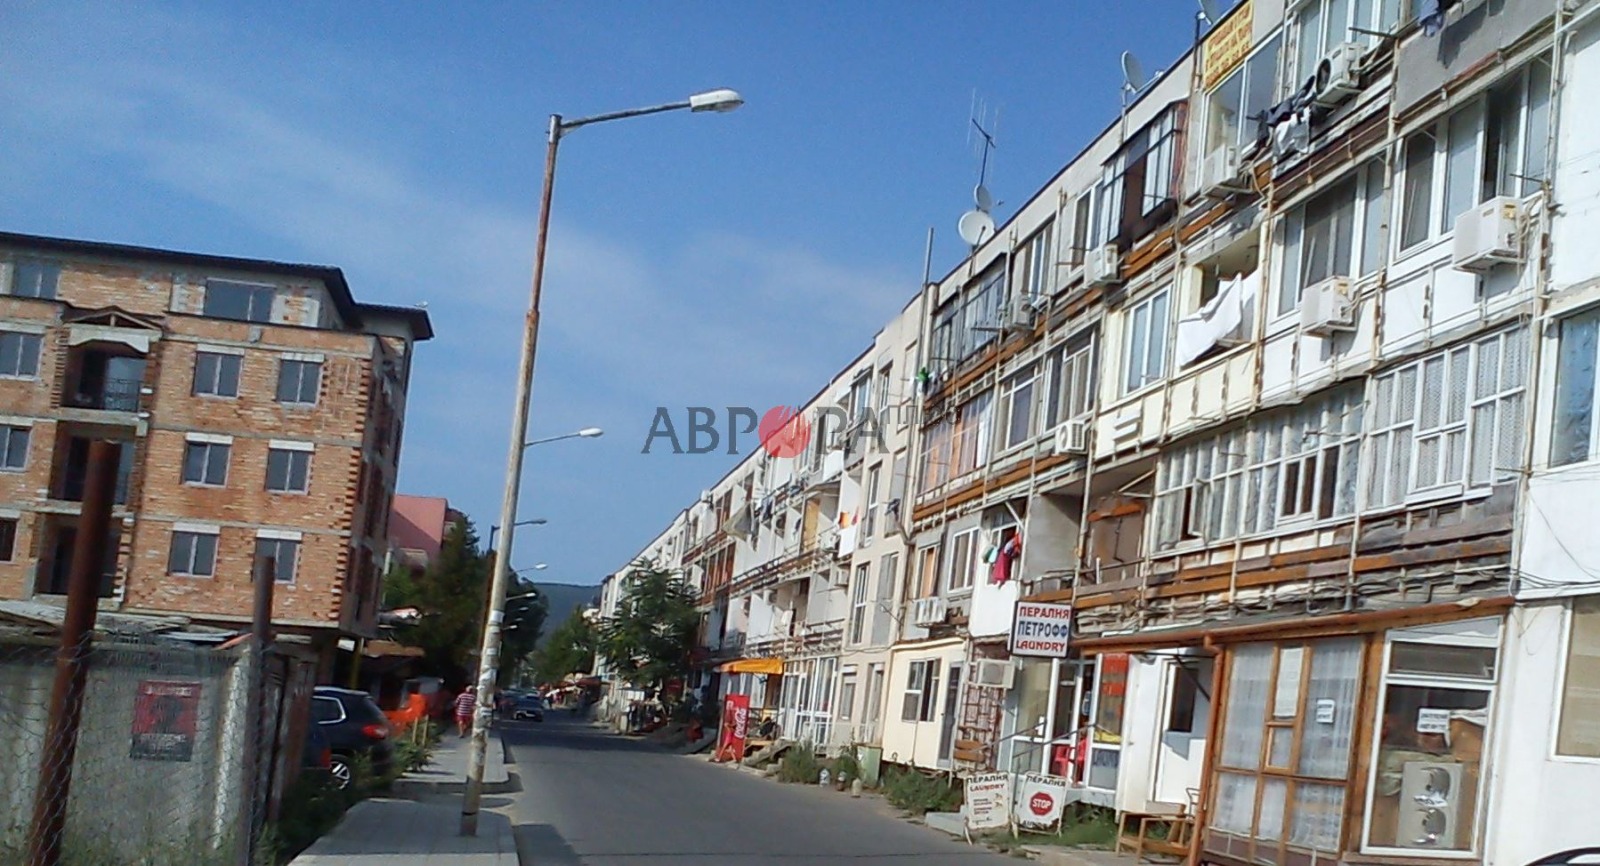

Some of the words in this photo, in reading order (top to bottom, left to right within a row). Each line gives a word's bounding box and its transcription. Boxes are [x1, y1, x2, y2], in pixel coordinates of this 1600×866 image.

[1019, 606, 1069, 619] ПЕРАЛНЯ
[1018, 620, 1067, 638] ПЕТРОФФ
[1016, 640, 1065, 652] LAUNDRY
[970, 783, 1004, 792] LAUNDRY
[1032, 798, 1052, 809] STOP
